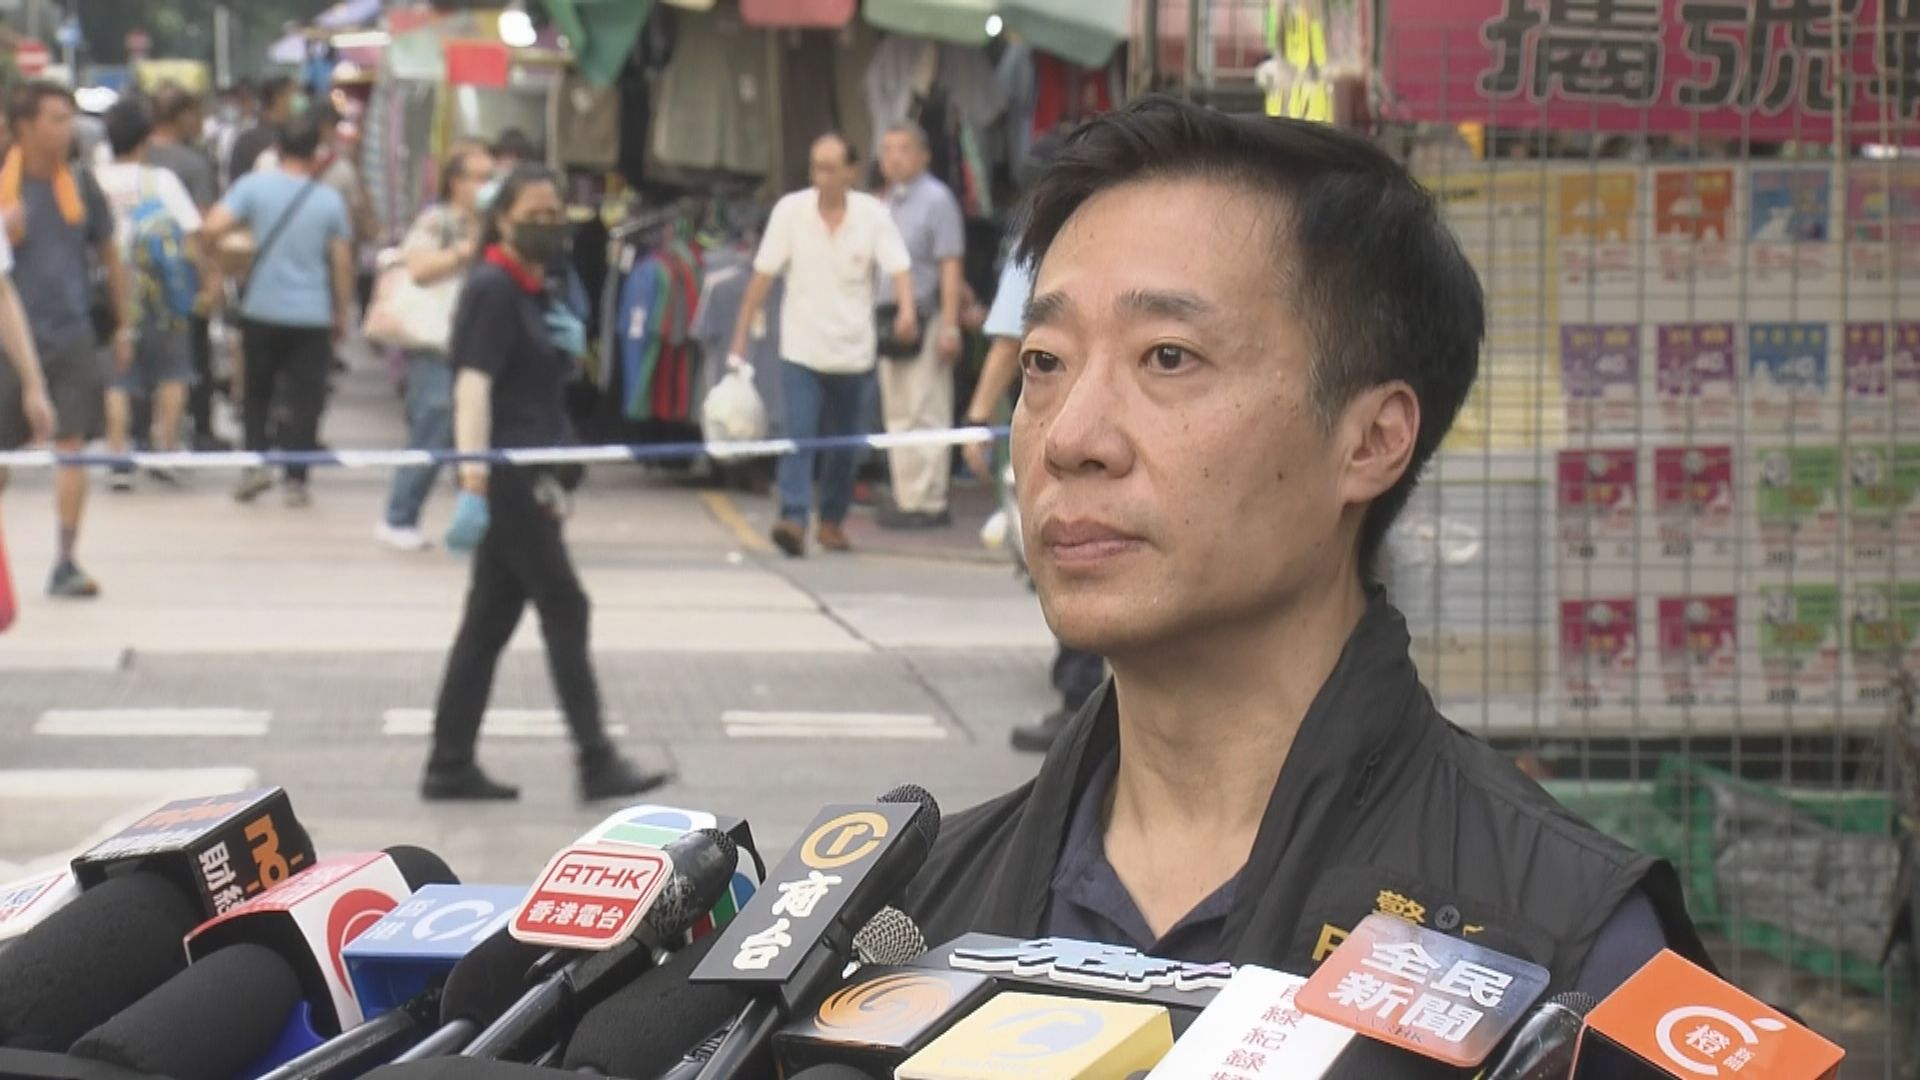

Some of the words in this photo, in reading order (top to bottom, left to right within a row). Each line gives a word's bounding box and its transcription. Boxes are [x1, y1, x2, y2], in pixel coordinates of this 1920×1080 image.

[555, 864, 651, 891] RTHK
[527, 900, 624, 930] 香港電台
[733, 870, 842, 969] 商台
[1328, 970, 1484, 1043] 新聞
[1361, 941, 1514, 1008] 全民
